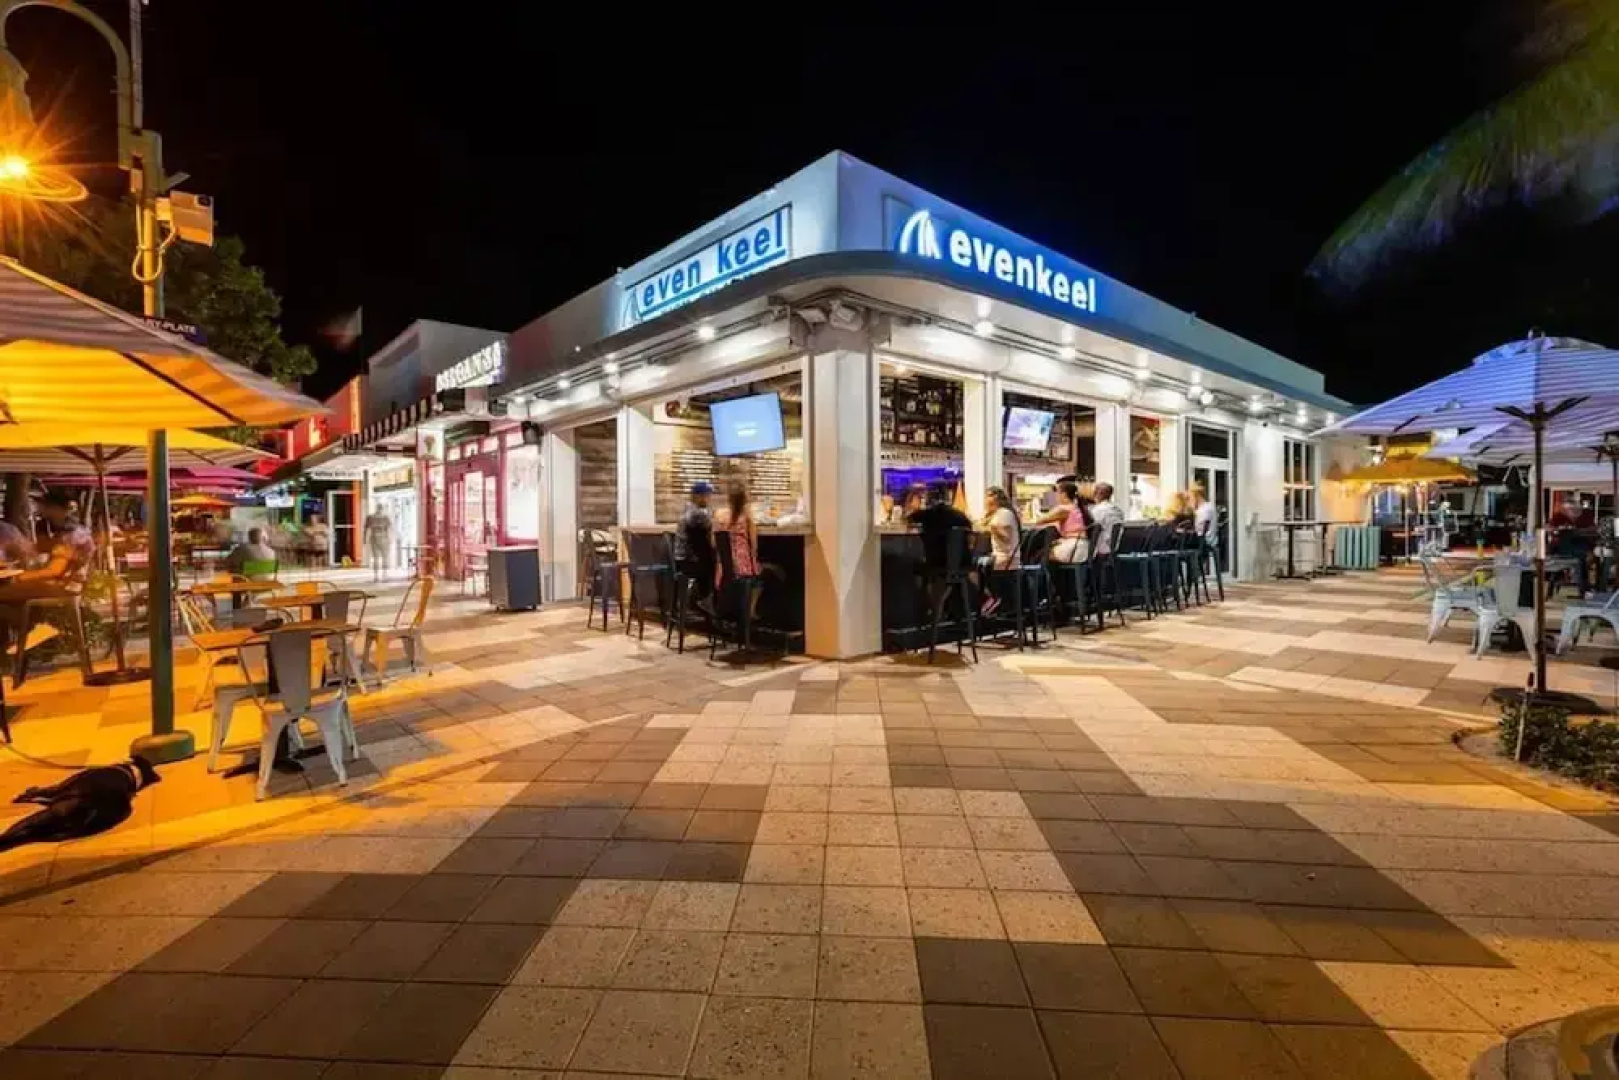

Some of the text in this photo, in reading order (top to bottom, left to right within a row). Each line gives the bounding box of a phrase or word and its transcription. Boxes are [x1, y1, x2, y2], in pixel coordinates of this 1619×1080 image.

[643, 210, 783, 307] even keel
[950, 230, 1096, 313] evenkeel
